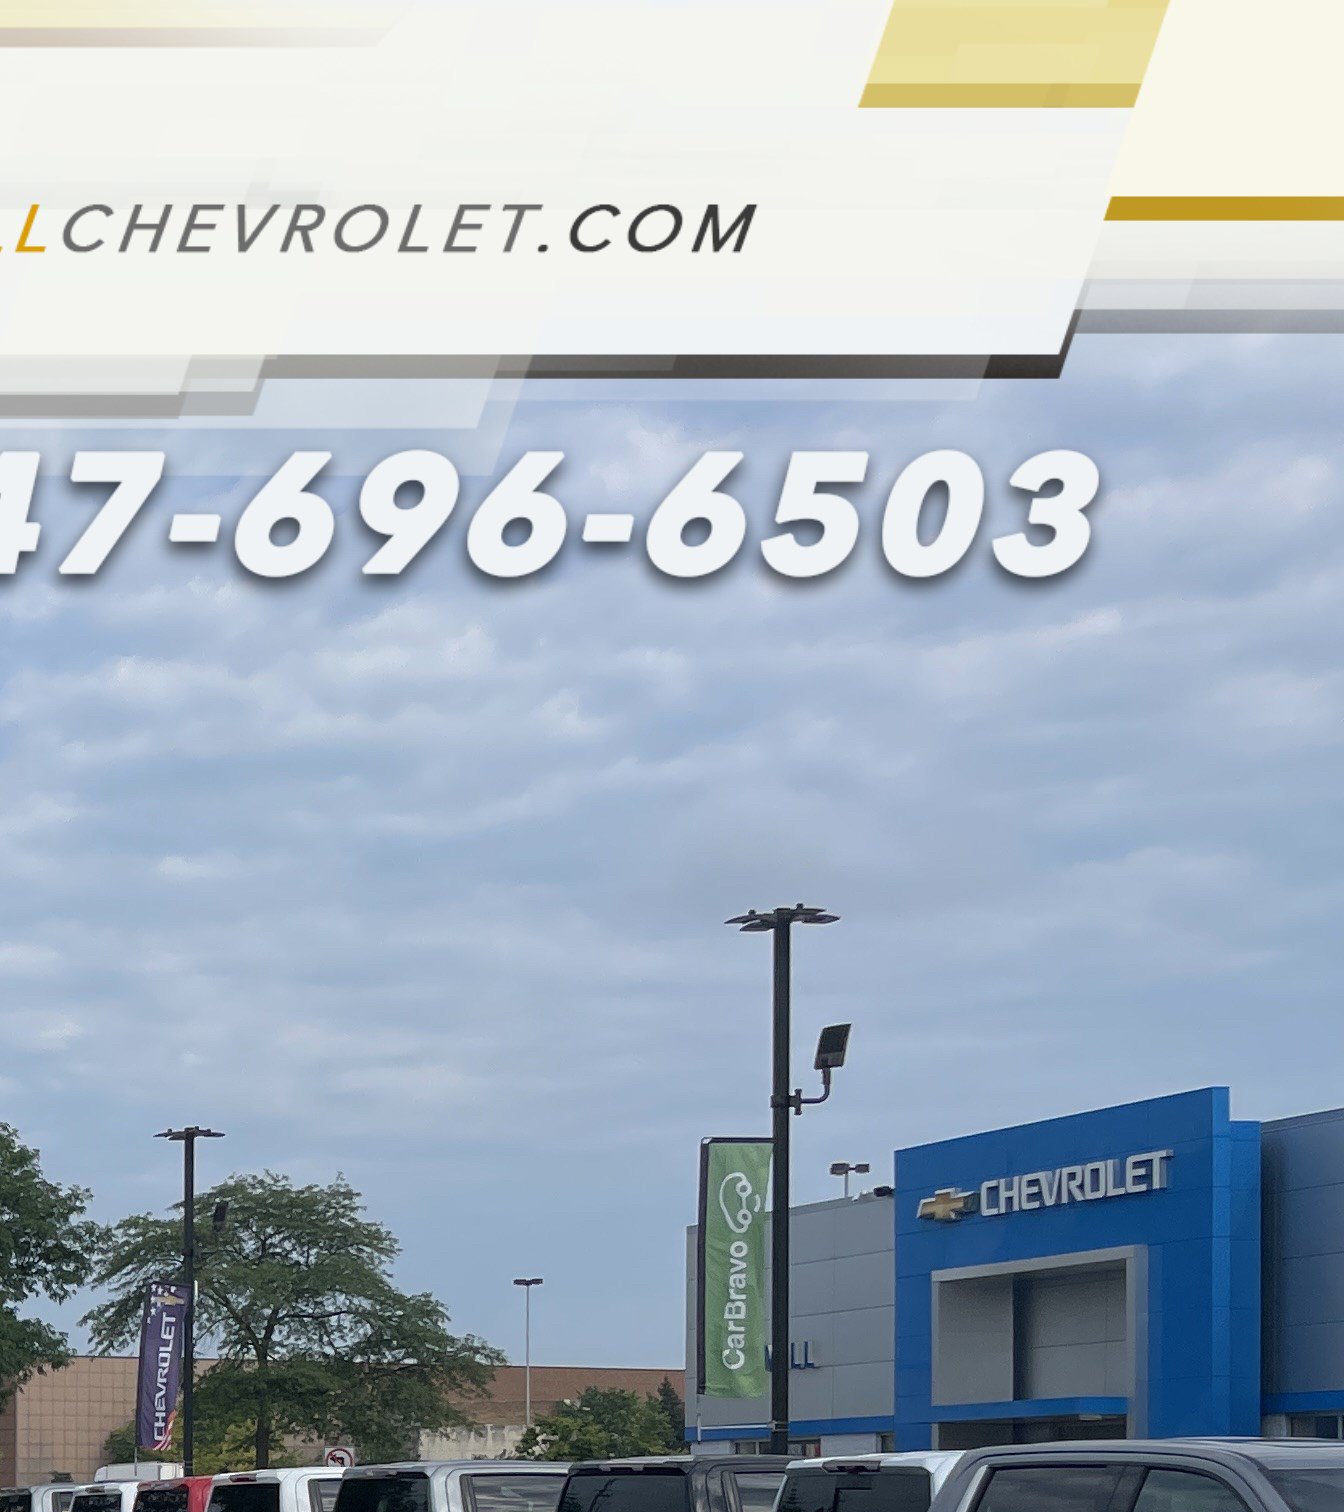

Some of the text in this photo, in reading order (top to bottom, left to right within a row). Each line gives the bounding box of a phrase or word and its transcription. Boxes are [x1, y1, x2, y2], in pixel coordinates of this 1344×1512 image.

[980, 1150, 1174, 1217] CHEVROLET
[722, 1240, 749, 1370] CarBravo
[153, 1311, 177, 1441] CHEVROLET
